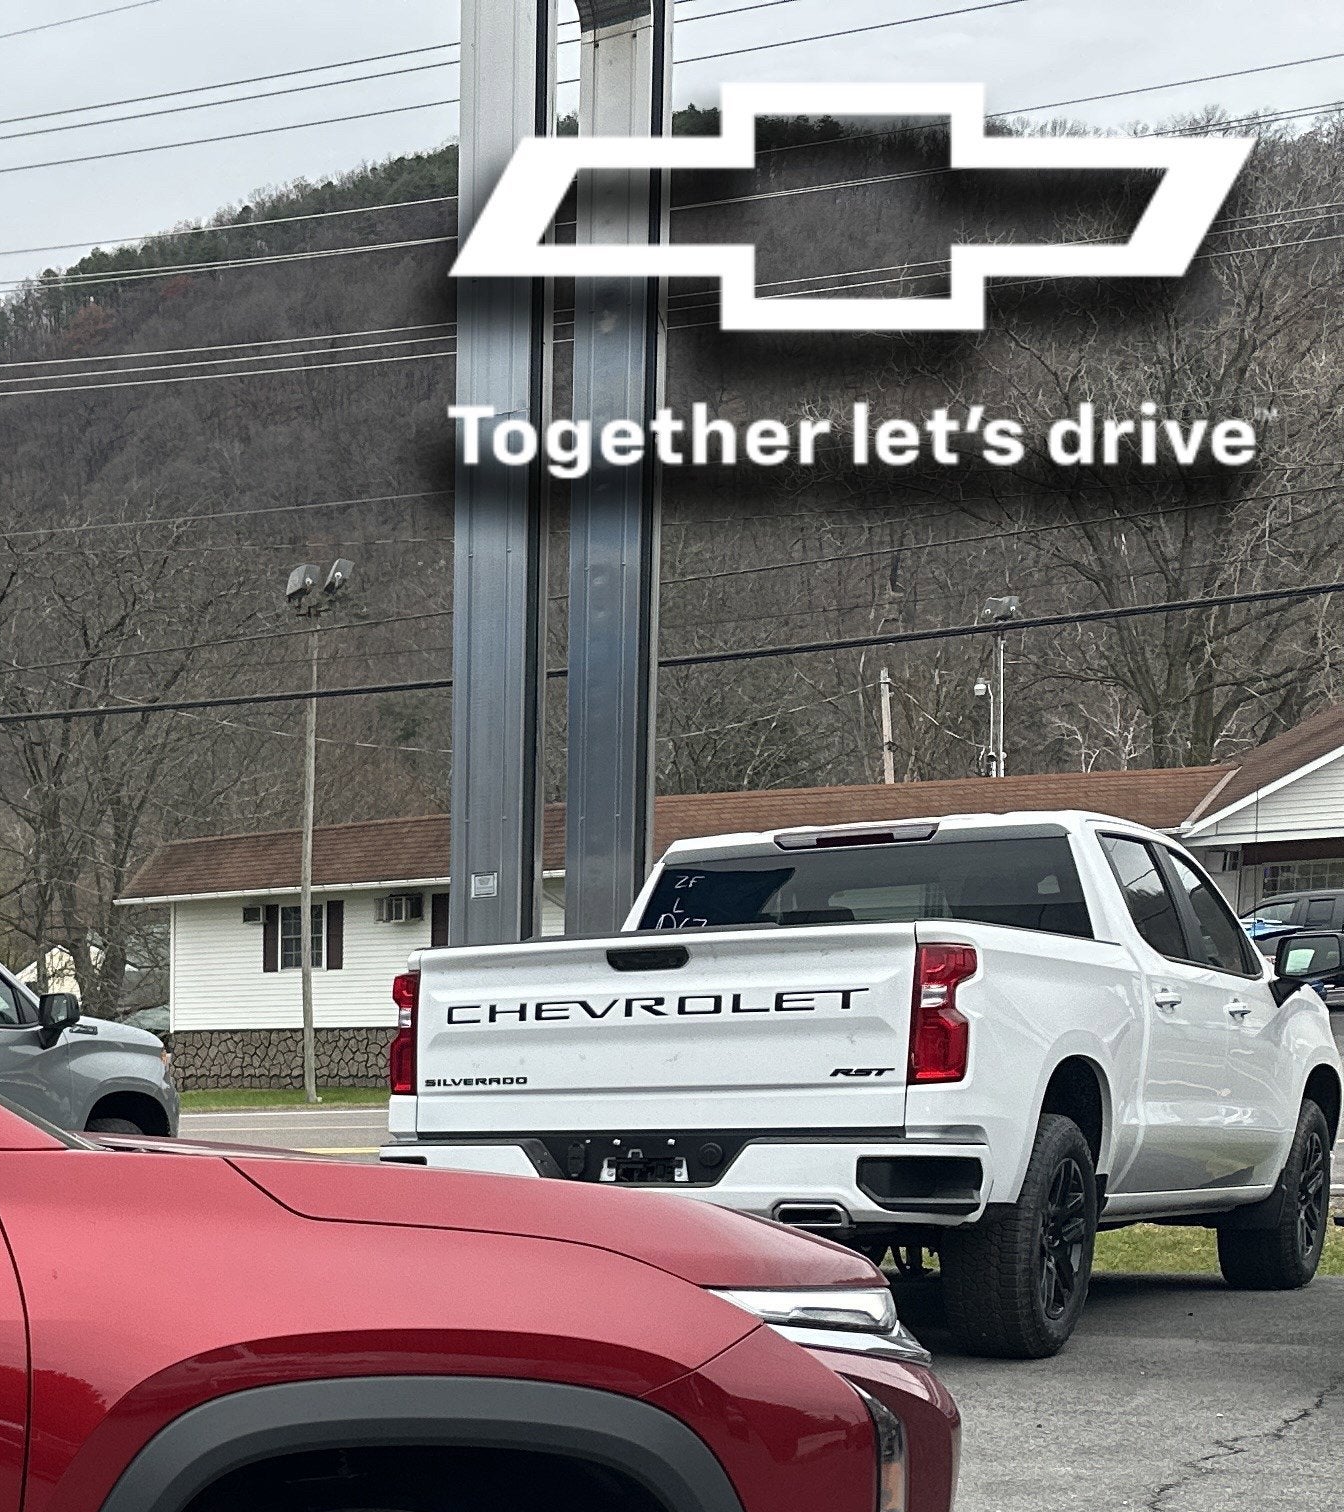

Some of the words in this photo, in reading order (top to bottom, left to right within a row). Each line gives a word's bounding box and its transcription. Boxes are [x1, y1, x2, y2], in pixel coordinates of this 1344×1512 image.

[446, 988, 869, 1025] CHEVROLET
[829, 1067, 896, 1077] RST
[425, 1076, 528, 1087] SILVERADO
